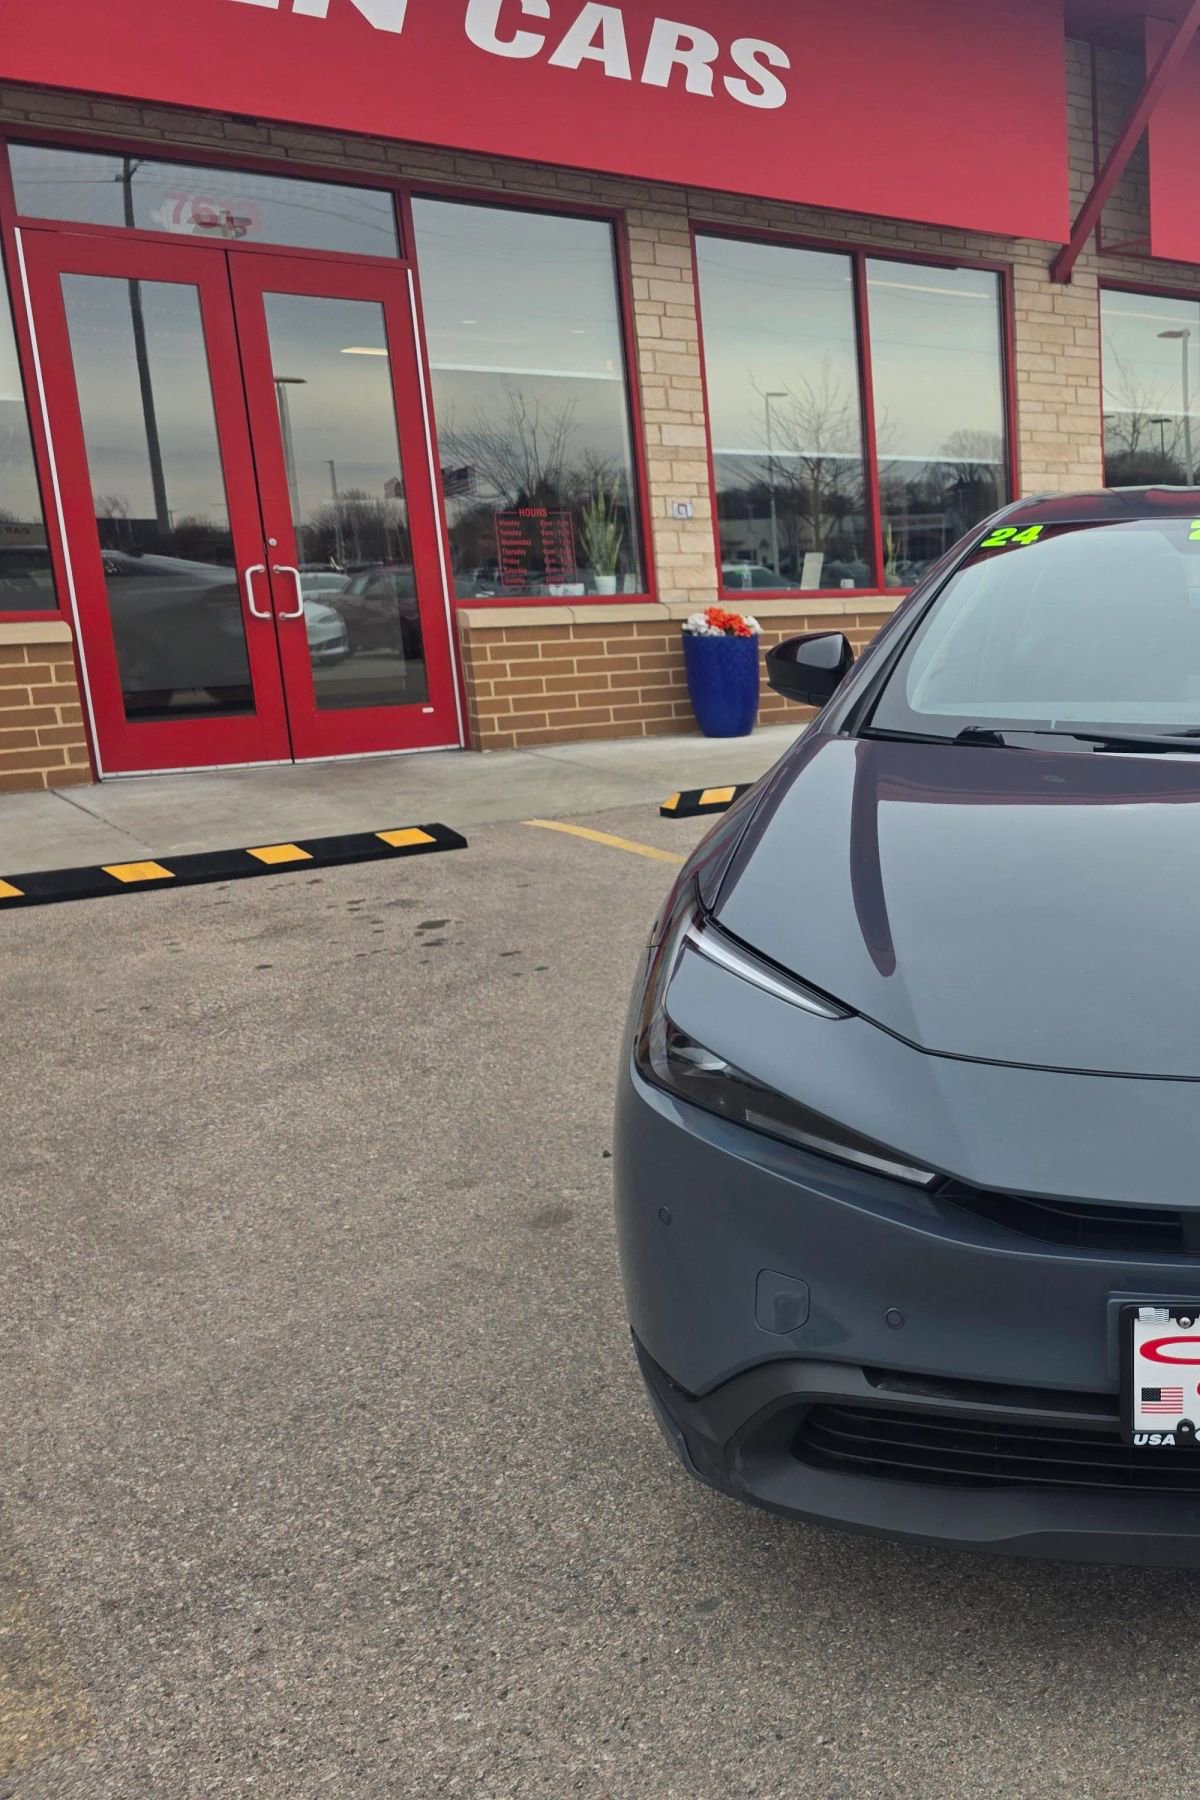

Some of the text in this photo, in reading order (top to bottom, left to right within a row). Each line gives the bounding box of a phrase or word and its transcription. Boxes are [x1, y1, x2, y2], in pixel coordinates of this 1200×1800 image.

[464, 0, 791, 109] CARS
[518, 507, 548, 517] HOURS
[980, 525, 1044, 548] 24
[1133, 1434, 1176, 1446] USA
